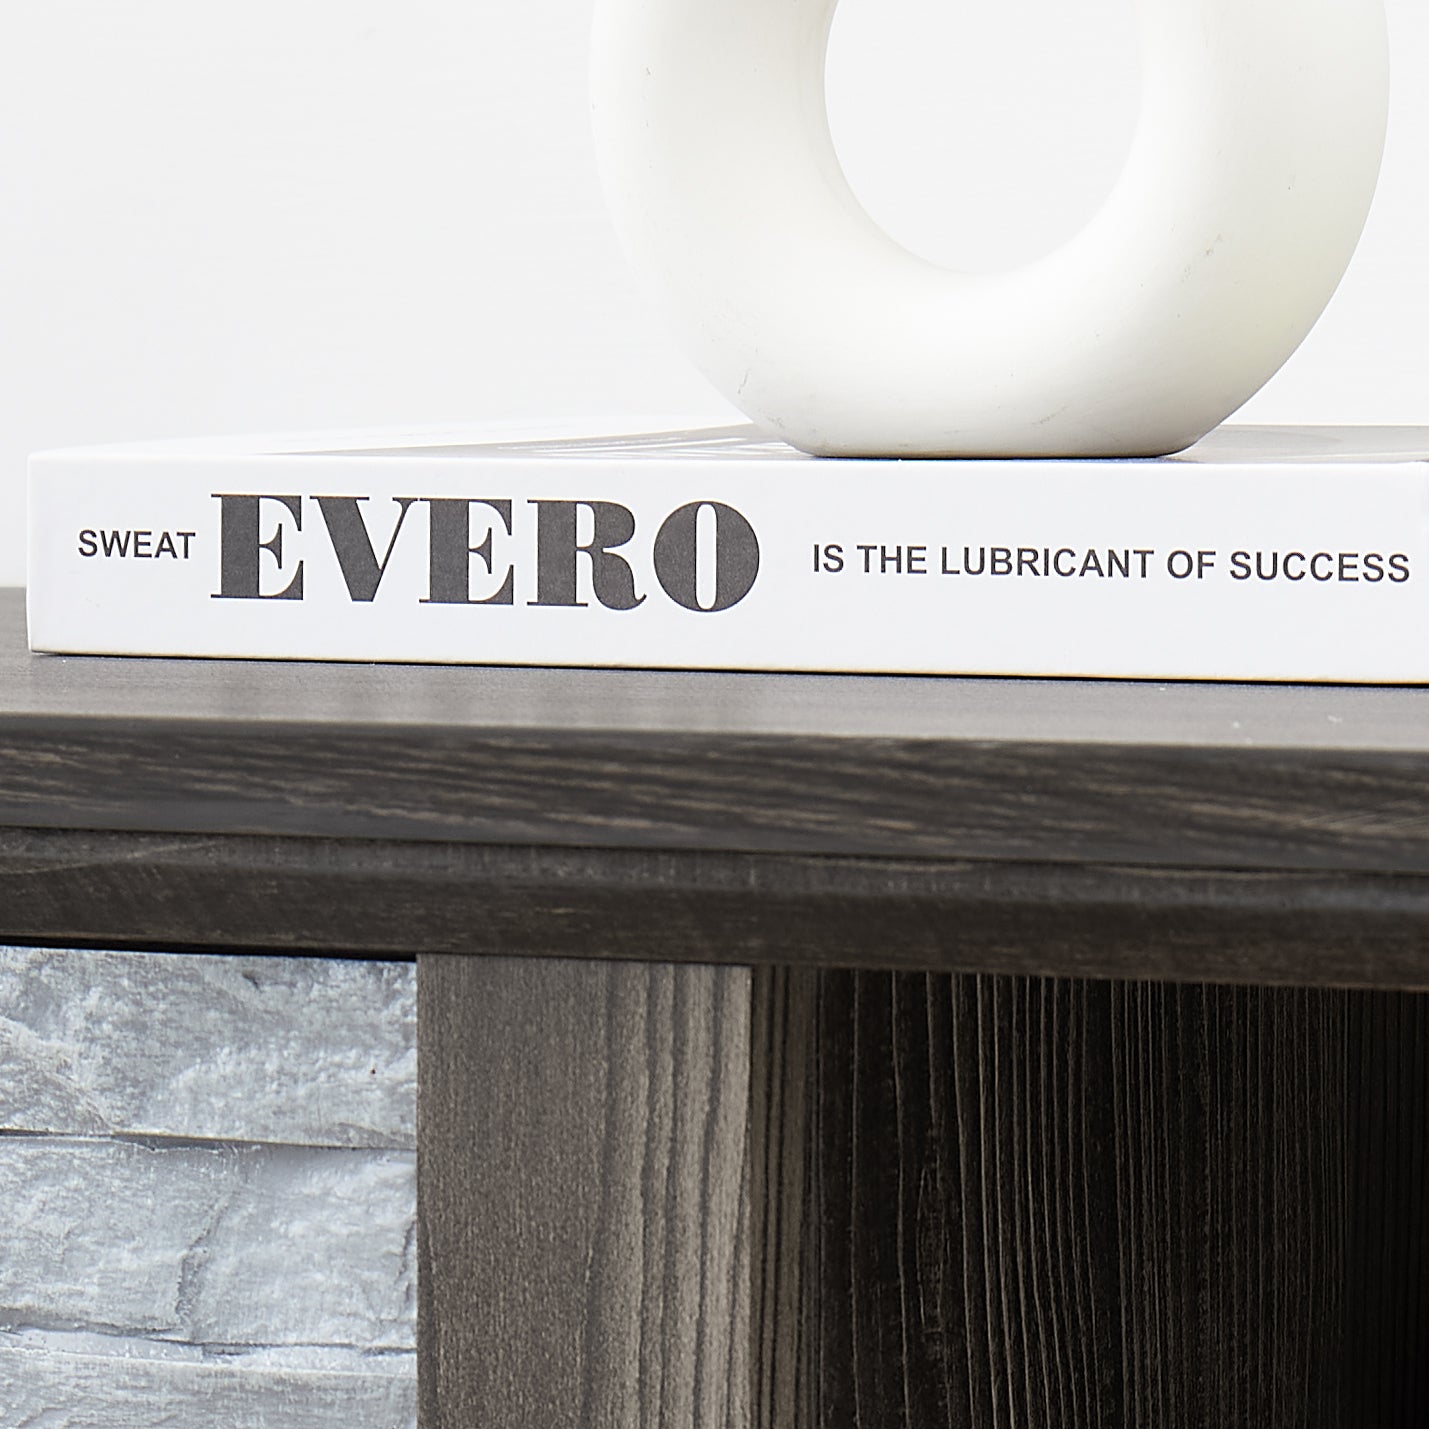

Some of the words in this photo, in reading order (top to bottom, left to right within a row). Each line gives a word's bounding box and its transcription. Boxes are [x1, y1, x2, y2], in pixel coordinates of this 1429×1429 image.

[79, 529, 196, 560] SWEAT
[211, 493, 760, 612] EVERO
[813, 544, 843, 573] IS
[856, 545, 927, 574] THE
[941, 546, 1155, 579] LUBRICANT
[1167, 550, 1217, 580] OF
[1229, 551, 1410, 583] SUCCESS
